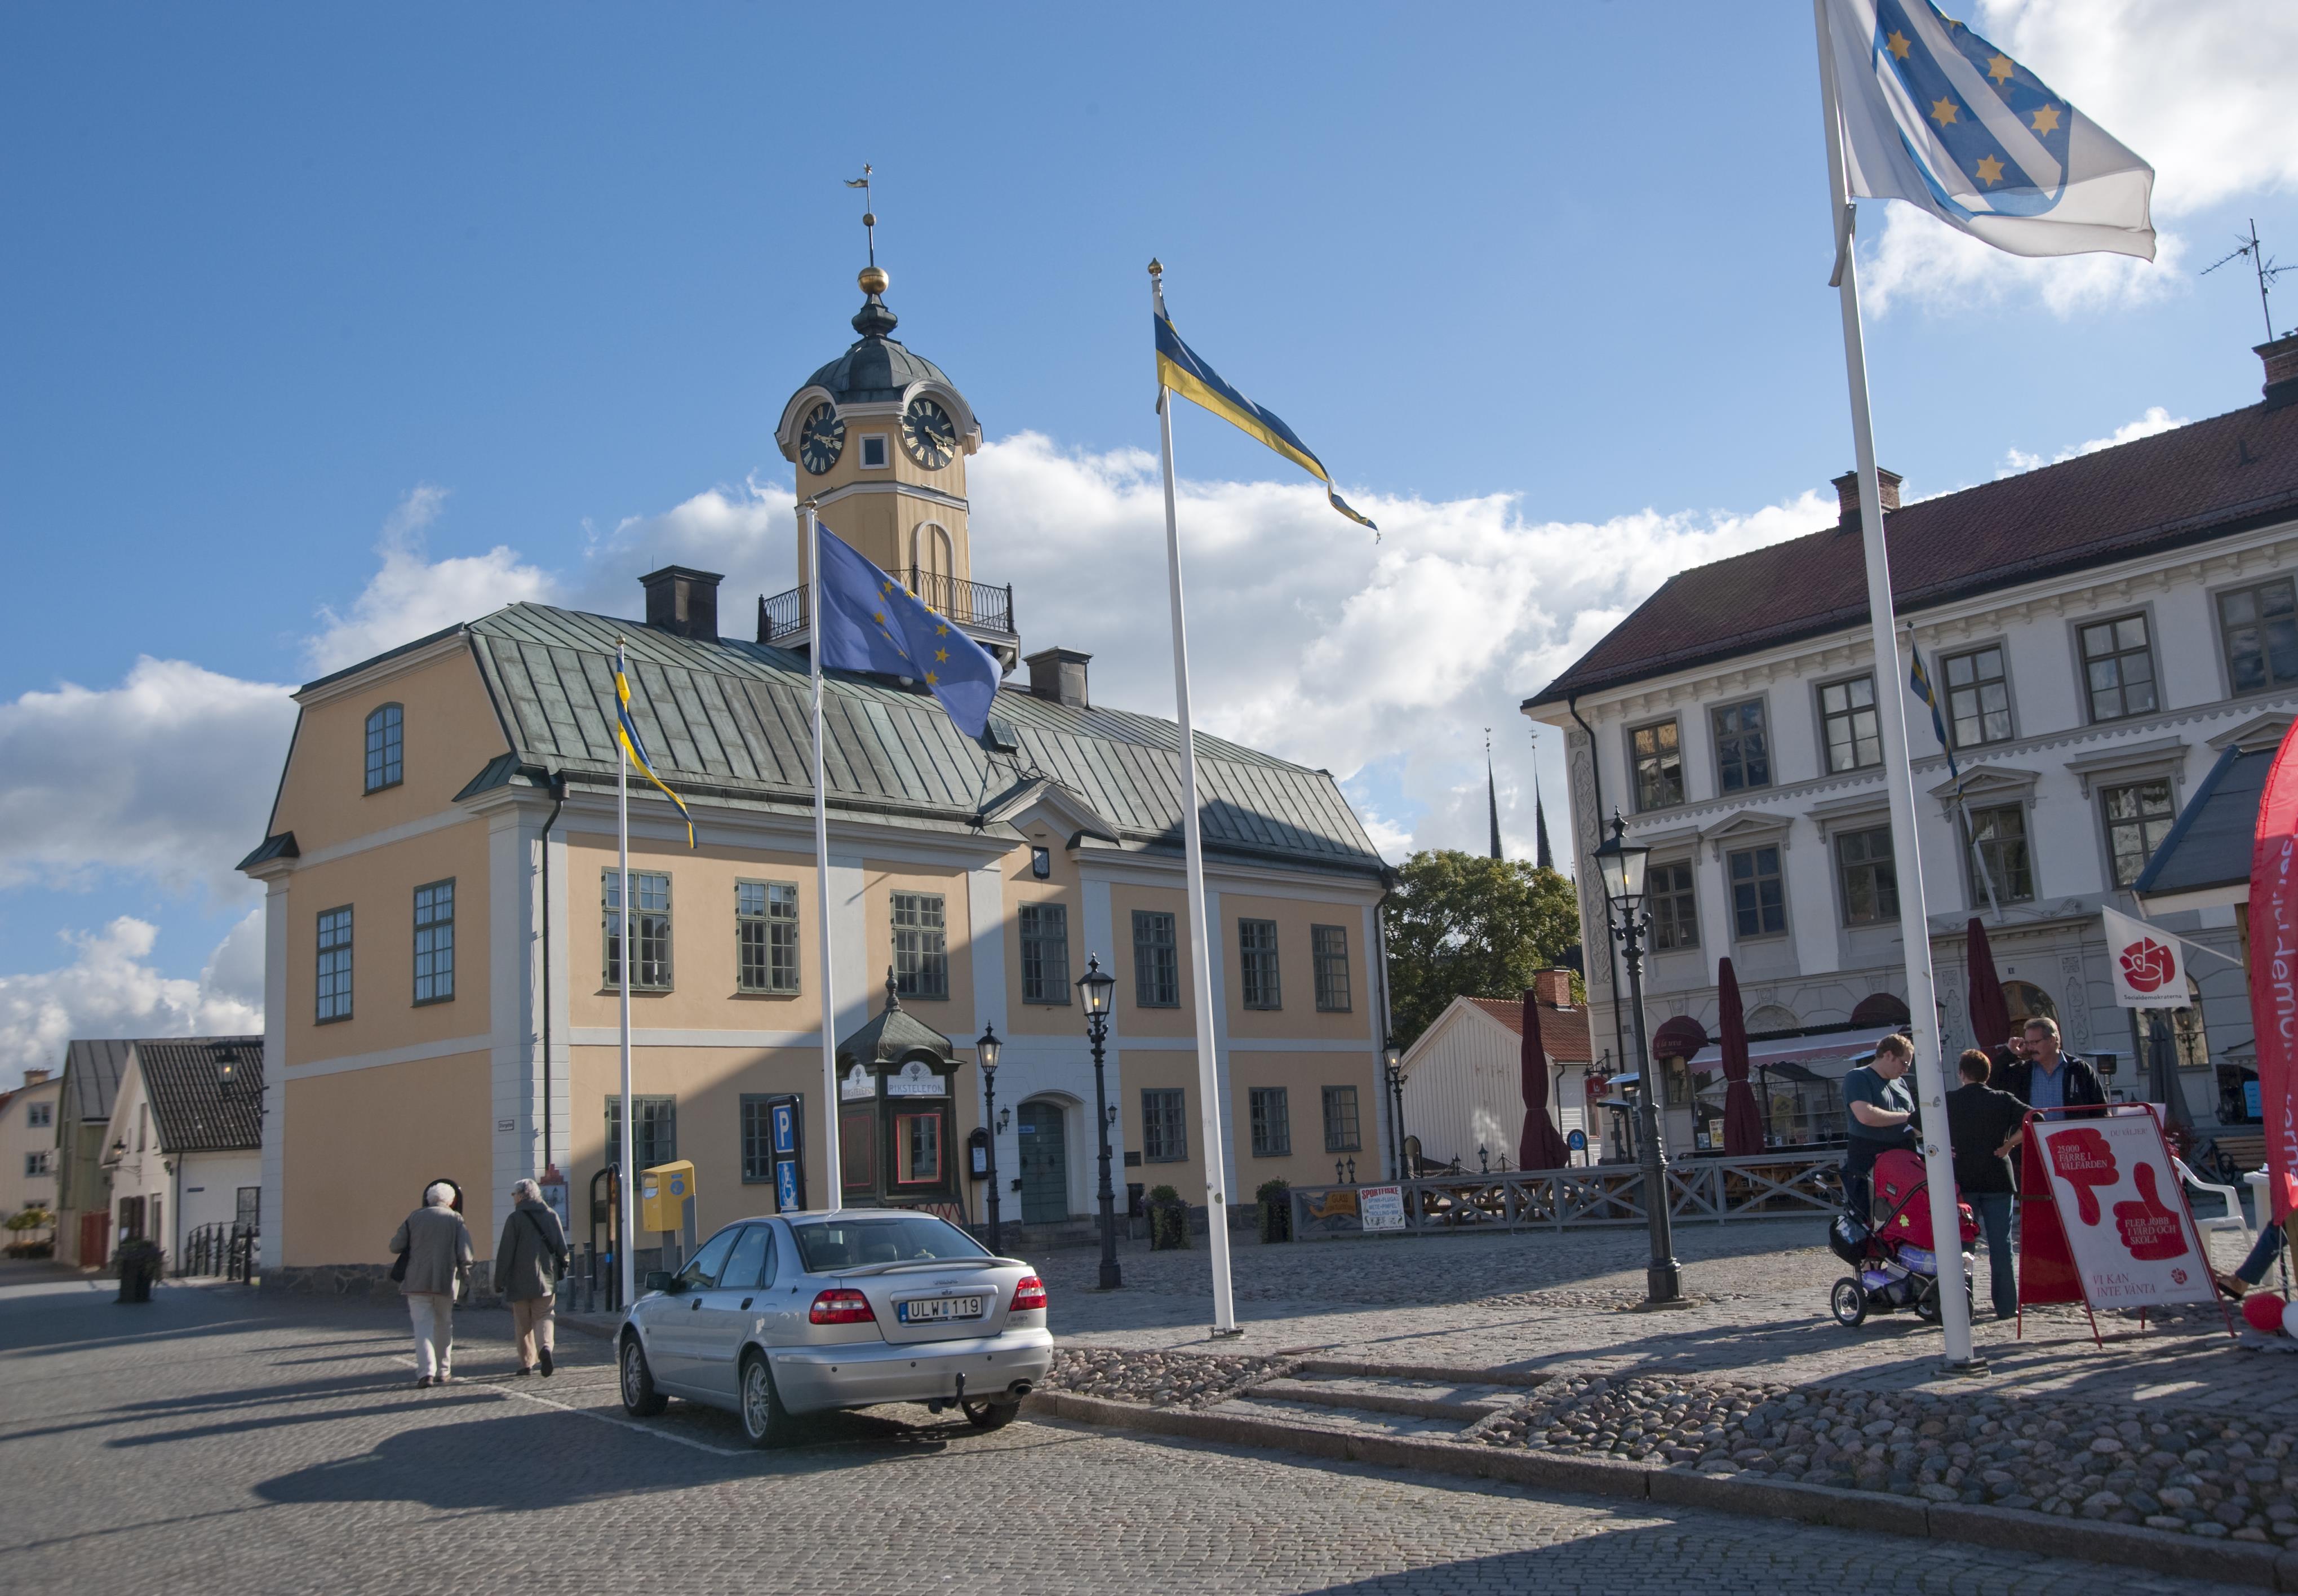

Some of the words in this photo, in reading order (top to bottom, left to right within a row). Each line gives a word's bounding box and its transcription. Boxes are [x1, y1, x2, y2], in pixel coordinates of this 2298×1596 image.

[842, 1086, 875, 1097] RIKSTELEFON
[889, 1084, 943, 1093] RIKSTELEFON
[779, 1111, 789, 1147] P
[2087, 1152, 2092, 1160] I
[2061, 1159, 2108, 1171] VÄLFÄRDEN
[1361, 1187, 1399, 1200] SPORTFISKE
[2124, 1218, 2146, 1227] FLER
[2148, 1217, 2169, 1226] JOBB
[2132, 1225, 2155, 1236] VÅRD
[2157, 1224, 2176, 1235] OCH
[2130, 1235, 2159, 1245] SKOLA
[2093, 1275, 2104, 1285] VI
[2106, 1273, 2130, 1284] KAN
[2097, 1285, 2122, 1298] INTE
[2124, 1282, 2156, 1295] VÄNTA
[911, 1301, 939, 1318] ULW
[952, 1298, 978, 1314] 119
